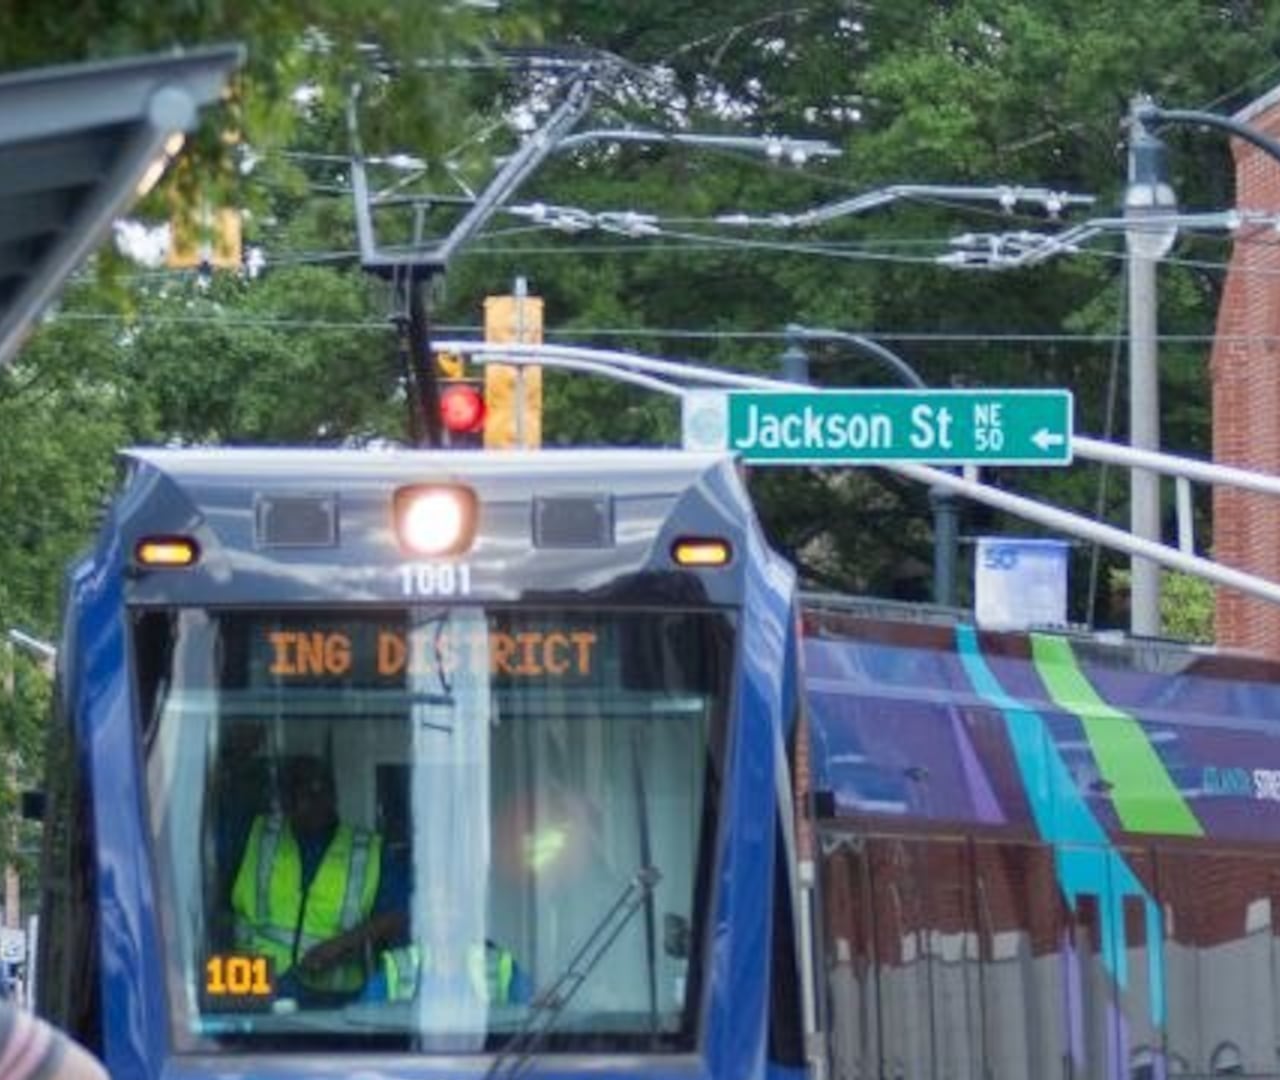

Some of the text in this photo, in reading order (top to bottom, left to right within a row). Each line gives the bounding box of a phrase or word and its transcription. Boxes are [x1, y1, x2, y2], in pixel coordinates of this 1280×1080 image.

[736, 404, 953, 450] Jackson St
[973, 403, 1001, 427] NE
[974, 428, 1004, 451] 50
[402, 564, 472, 596] 1001
[269, 633, 596, 676] ING DISTRICT
[206, 956, 271, 995] 101
